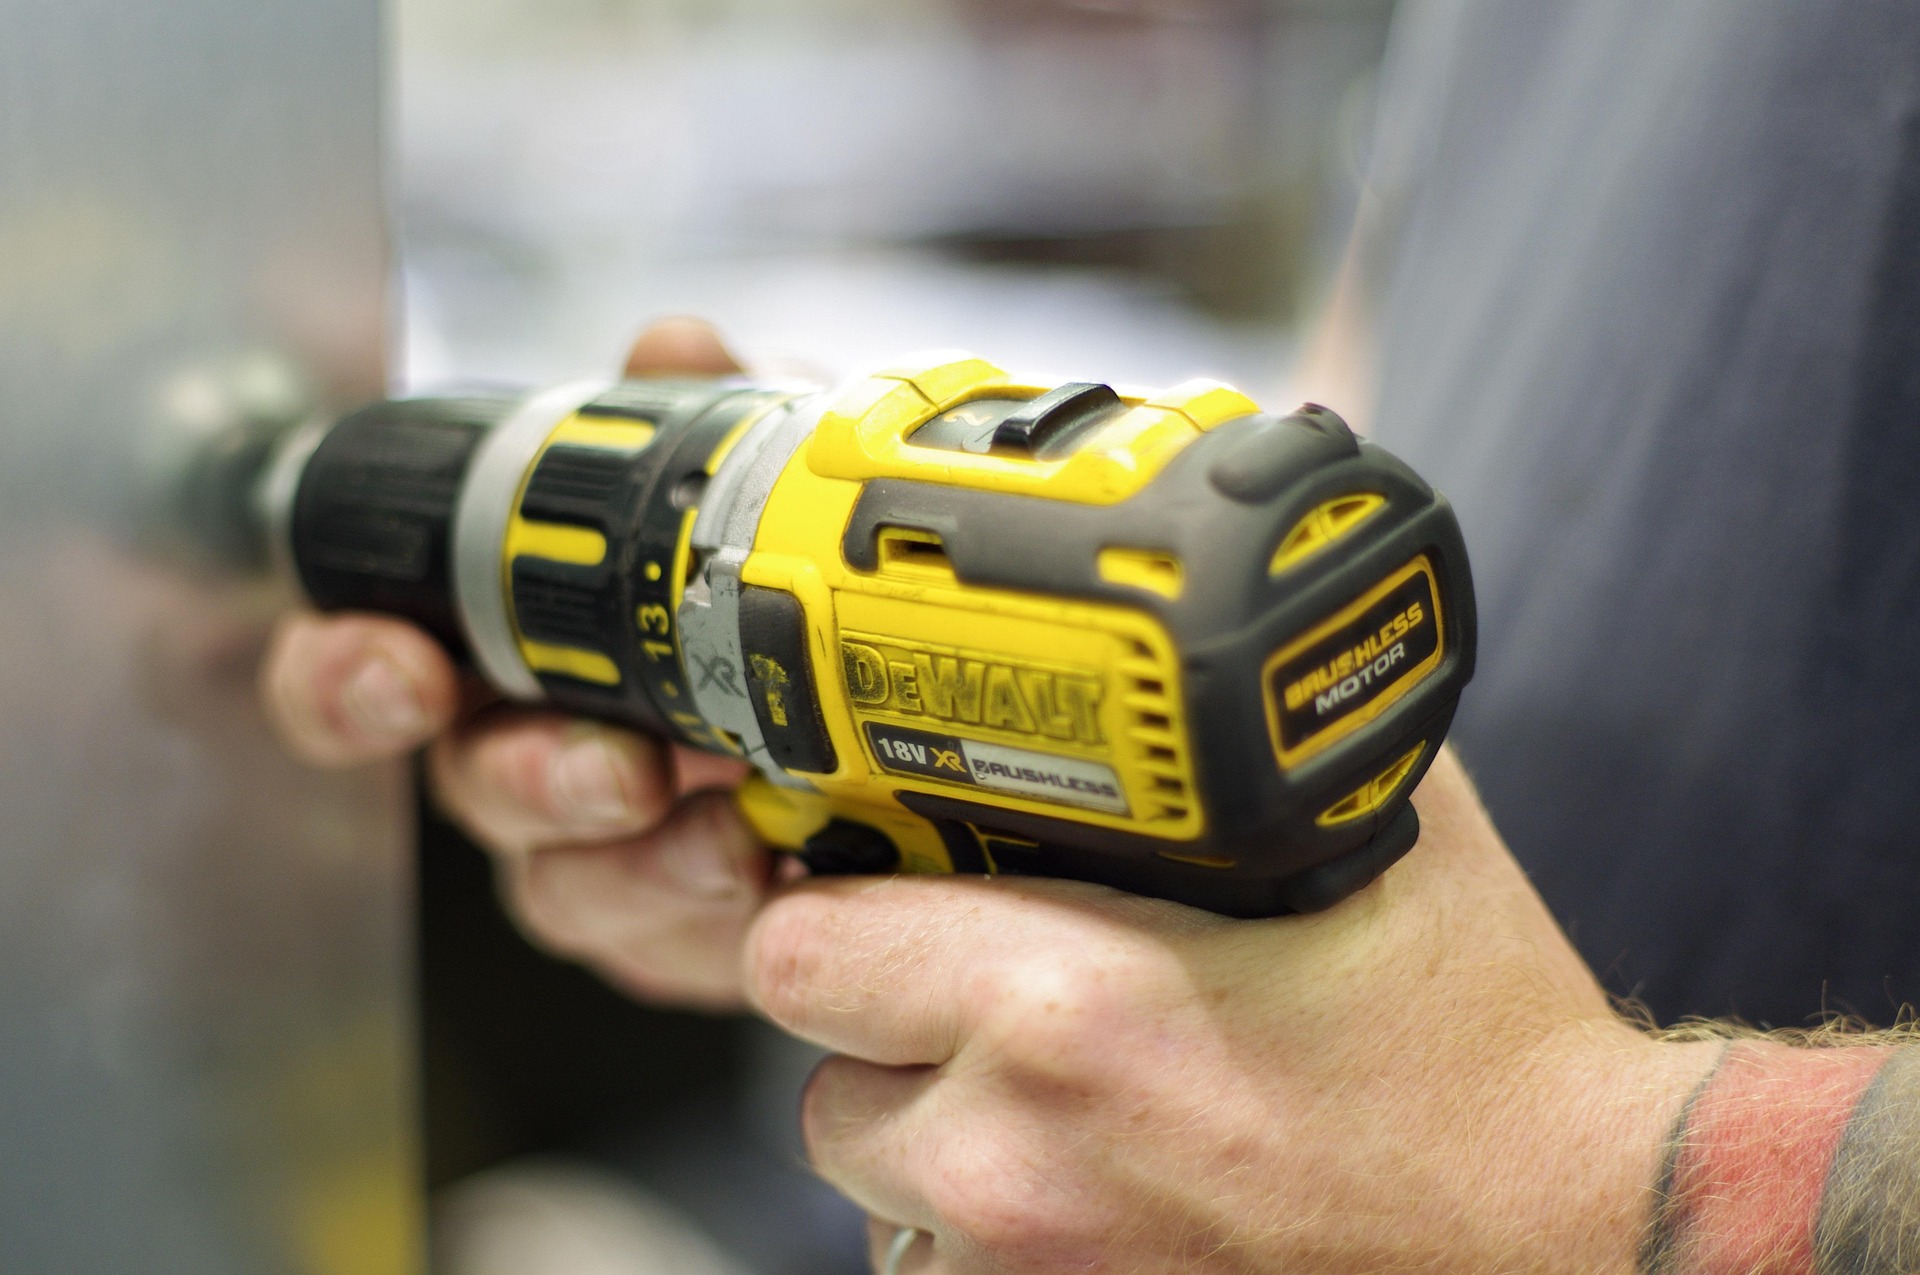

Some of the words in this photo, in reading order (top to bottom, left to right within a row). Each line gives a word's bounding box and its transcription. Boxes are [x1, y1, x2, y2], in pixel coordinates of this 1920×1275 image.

[636, 602, 673, 661] 13
[1284, 601, 1424, 711] BRUSHLESS
[693, 652, 747, 699] XR
[1314, 642, 1405, 716] MOTOR
[877, 737, 927, 765] 18V
[930, 746, 968, 773] XR
[971, 758, 1118, 798] BRUSHLESS
